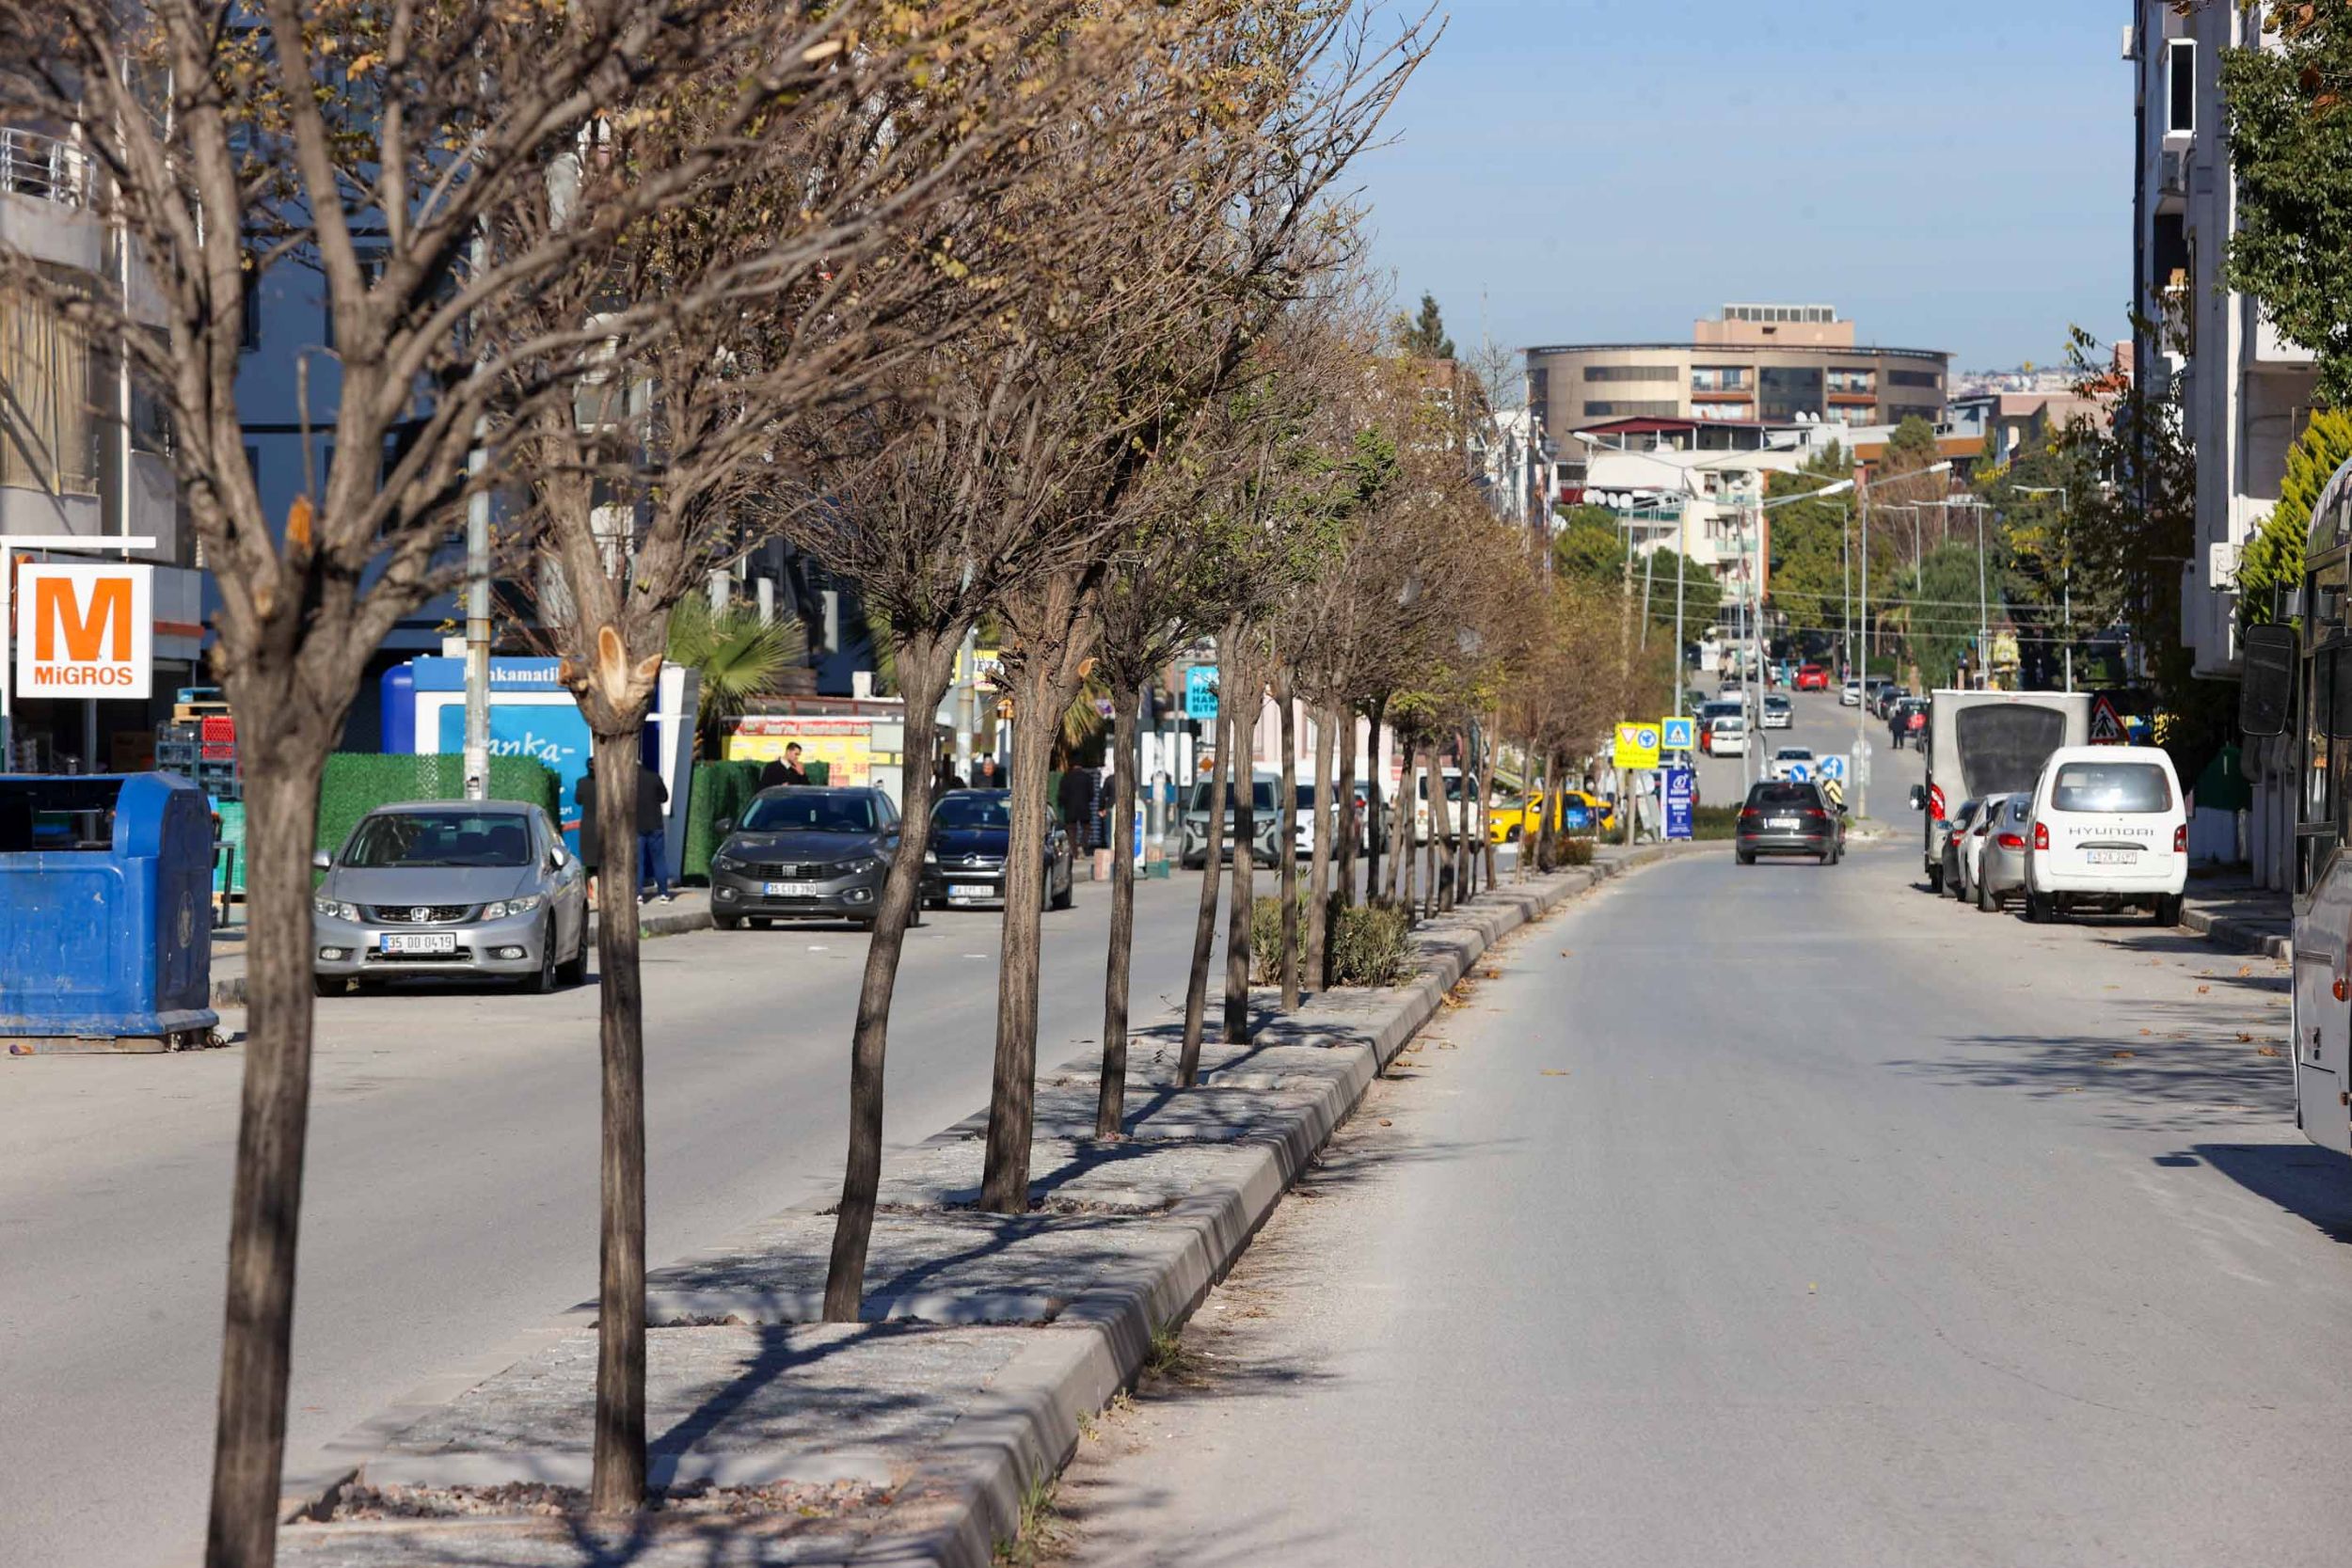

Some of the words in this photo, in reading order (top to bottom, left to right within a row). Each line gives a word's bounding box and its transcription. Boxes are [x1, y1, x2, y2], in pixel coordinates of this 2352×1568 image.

[35, 578, 133, 661] M
[35, 667, 133, 686] MiGROS
[462, 666, 560, 682] nkamati
[462, 731, 576, 763] anka-
[2069, 827, 2153, 836] HYUNDAI
[389, 936, 402, 949] 35
